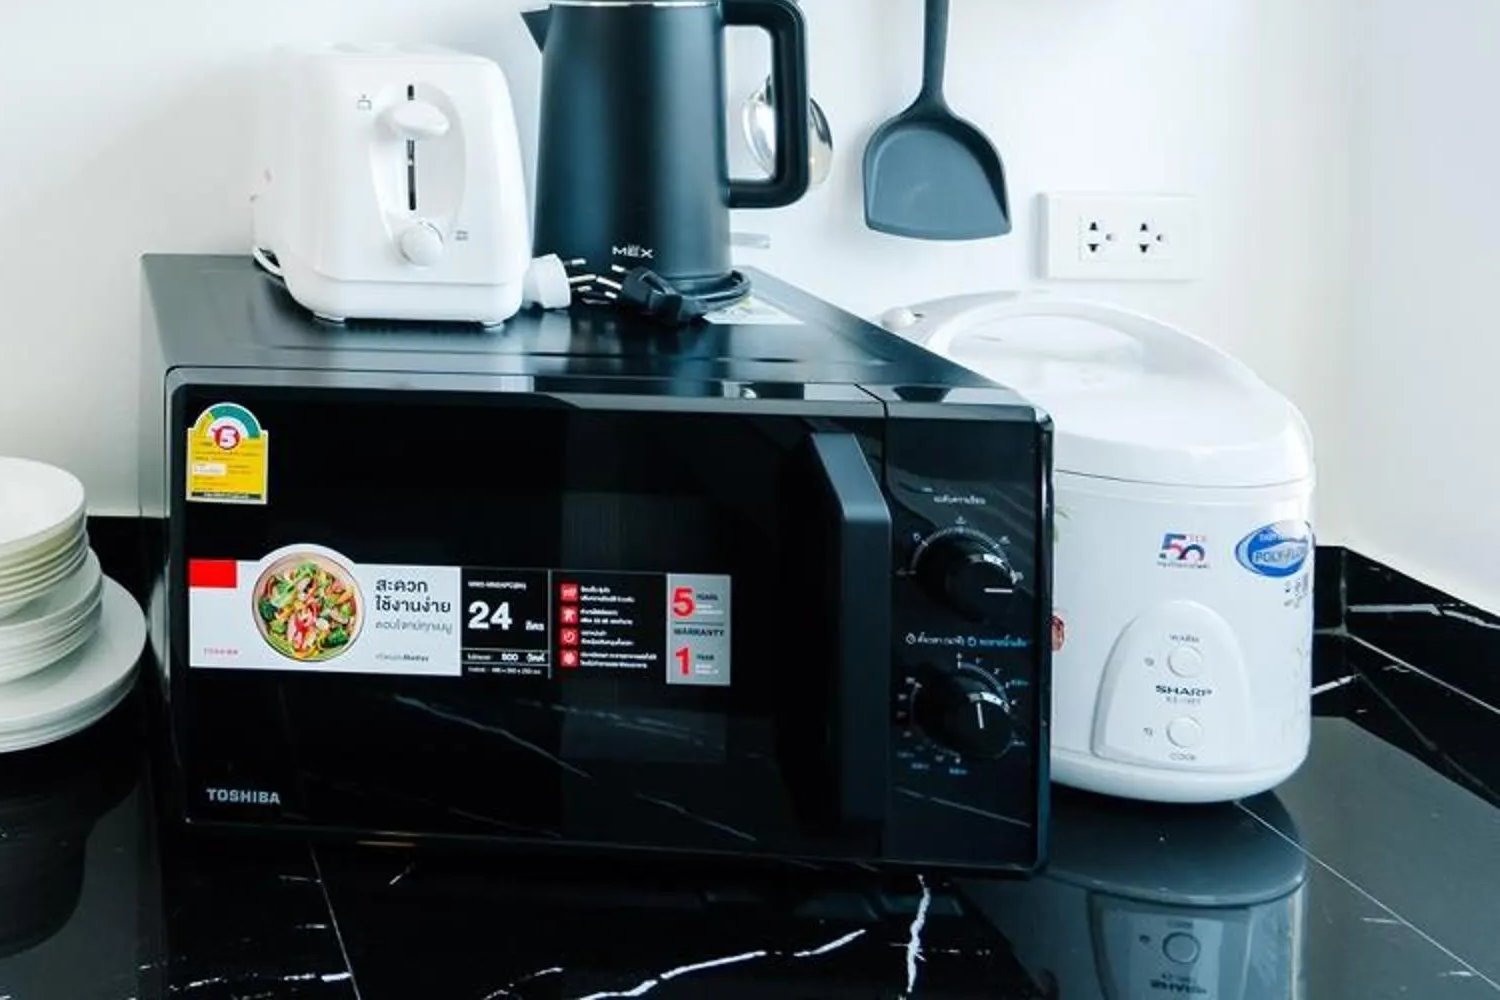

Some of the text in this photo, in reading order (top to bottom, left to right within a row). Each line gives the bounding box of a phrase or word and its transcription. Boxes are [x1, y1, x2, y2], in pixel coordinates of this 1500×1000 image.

[375, 595, 451, 613] ใช้งานง่าย
[674, 587, 694, 616] 5
[468, 601, 513, 630] 24
[675, 647, 689, 675] 1
[1155, 685, 1213, 697] SHARP
[205, 788, 280, 805] TOSHIBA
